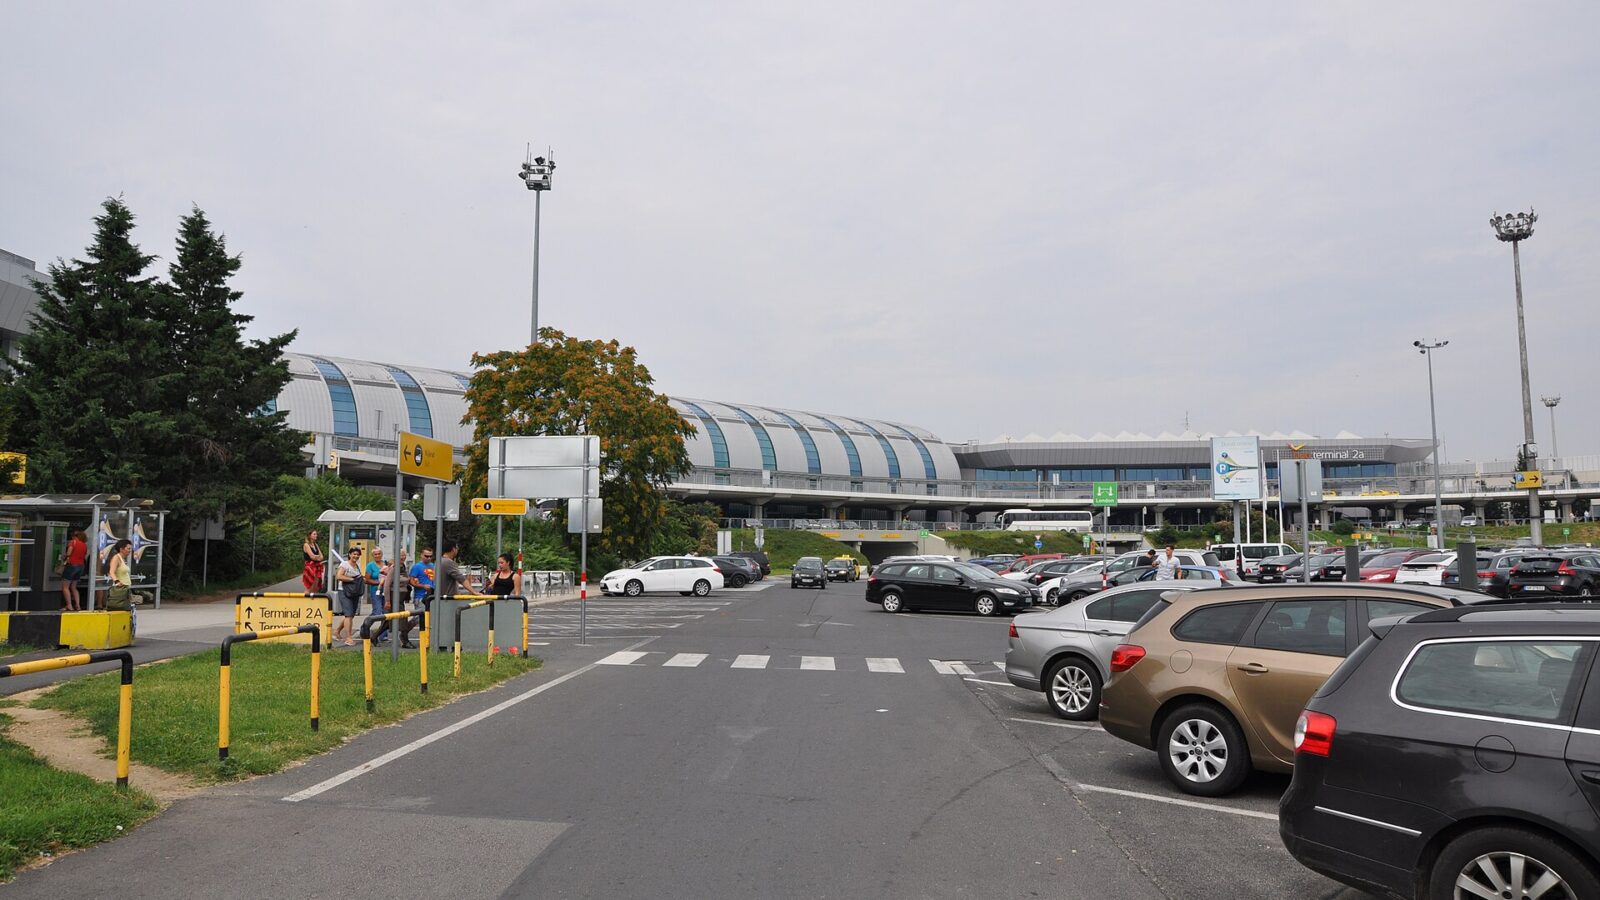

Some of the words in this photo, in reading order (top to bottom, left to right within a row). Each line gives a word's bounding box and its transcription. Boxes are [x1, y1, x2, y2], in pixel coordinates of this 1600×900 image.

[1312, 450, 1349, 459] terminal
[1352, 449, 1365, 459] 2a
[259, 606, 301, 618] Terminal
[305, 607, 323, 619] 2A
